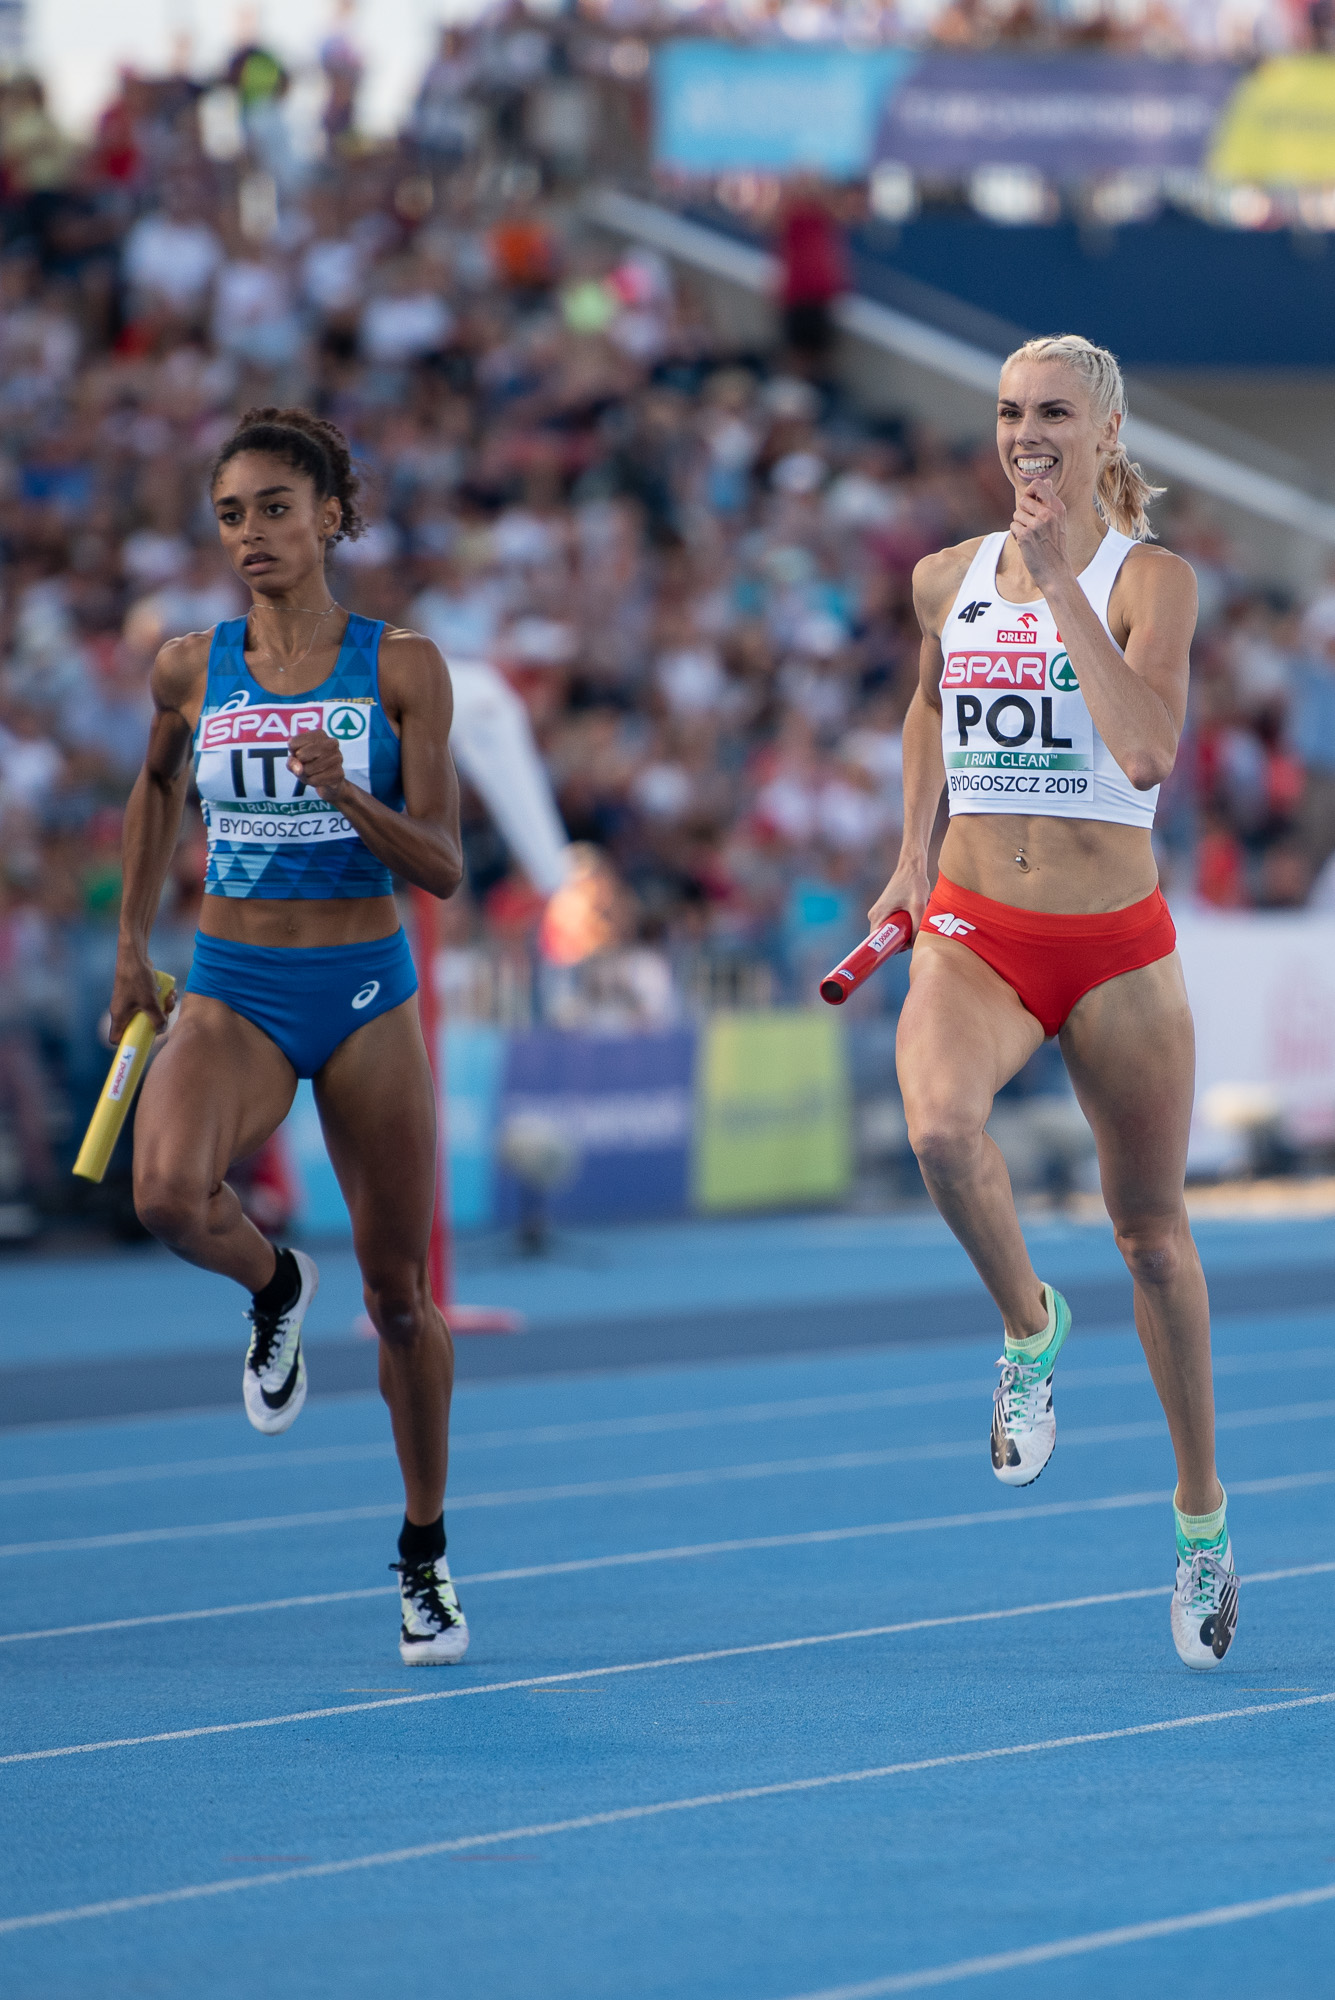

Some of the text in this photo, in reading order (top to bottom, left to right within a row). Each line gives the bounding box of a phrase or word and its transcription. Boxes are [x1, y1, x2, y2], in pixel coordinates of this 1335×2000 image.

[958, 601, 992, 623] 4F
[999, 631, 1035, 643] ORLEN
[945, 655, 1043, 685] SPAR
[205, 711, 320, 744] SPAR
[956, 694, 1072, 748] POL
[964, 754, 969, 766] I
[971, 753, 996, 766] RUN
[230, 748, 306, 798] IT
[950, 775, 1088, 794] BYDGOSZCZ 2019
[239, 800, 332, 814] I RUN CLEAN
[220, 817, 352, 837] BYDGOSZCZ 20
[929, 913, 976, 937] 4F
